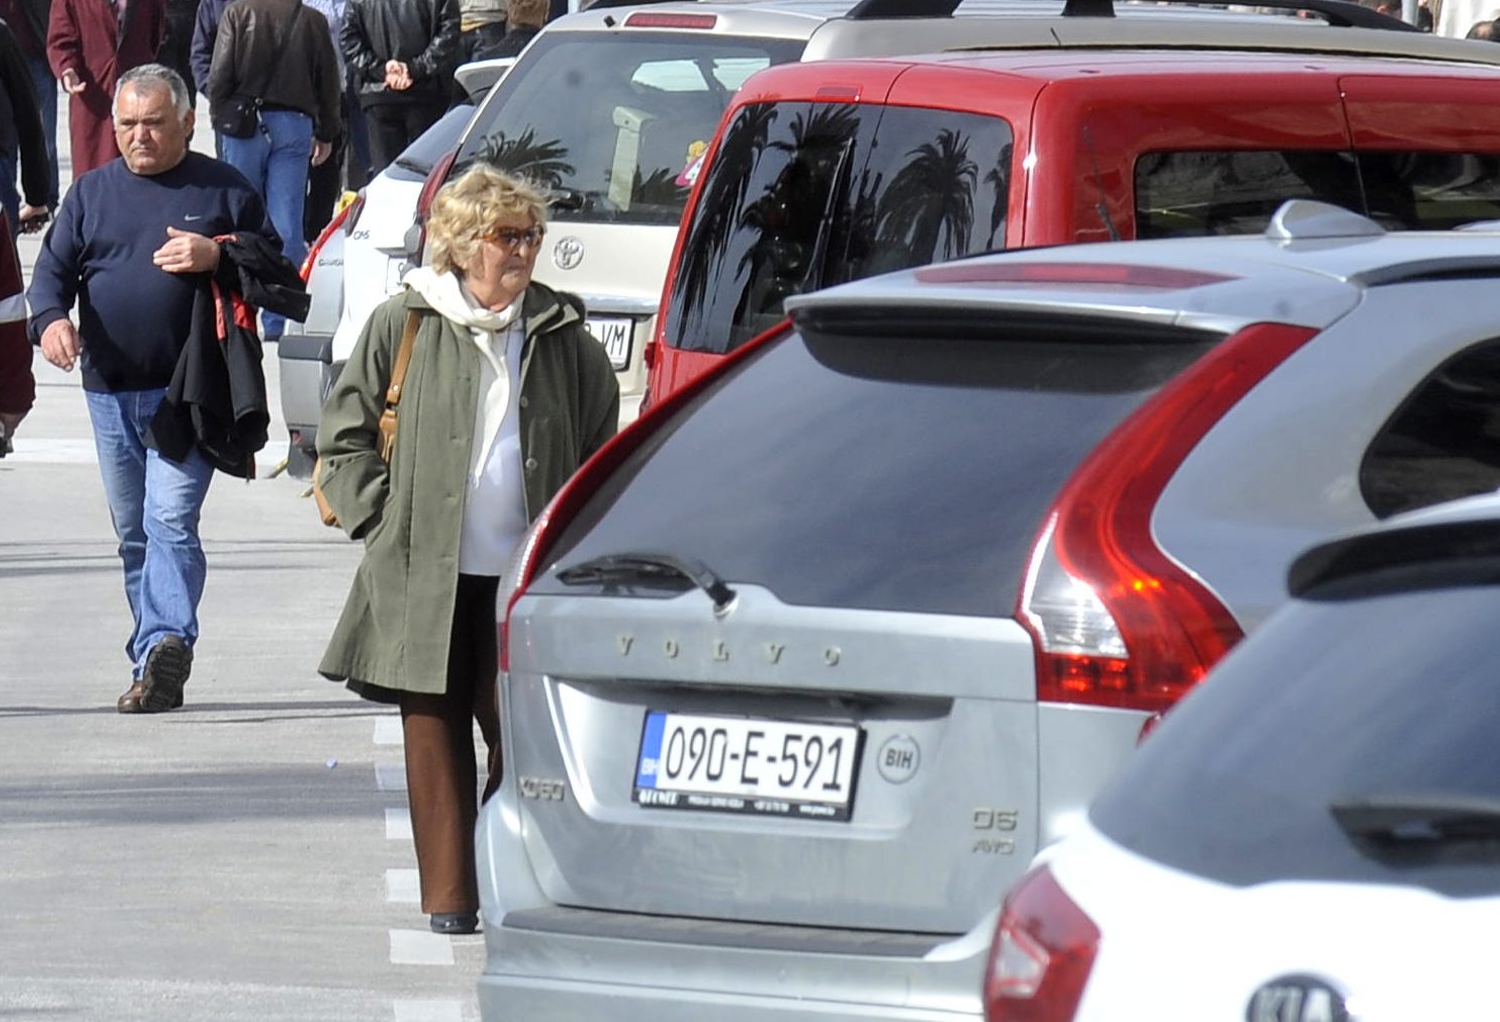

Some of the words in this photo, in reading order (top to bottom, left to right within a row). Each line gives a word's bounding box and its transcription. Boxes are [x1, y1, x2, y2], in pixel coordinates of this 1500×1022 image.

[618, 634, 842, 668] VOLVO
[665, 726, 844, 791] 090-E-591
[886, 748, 914, 770] BIH
